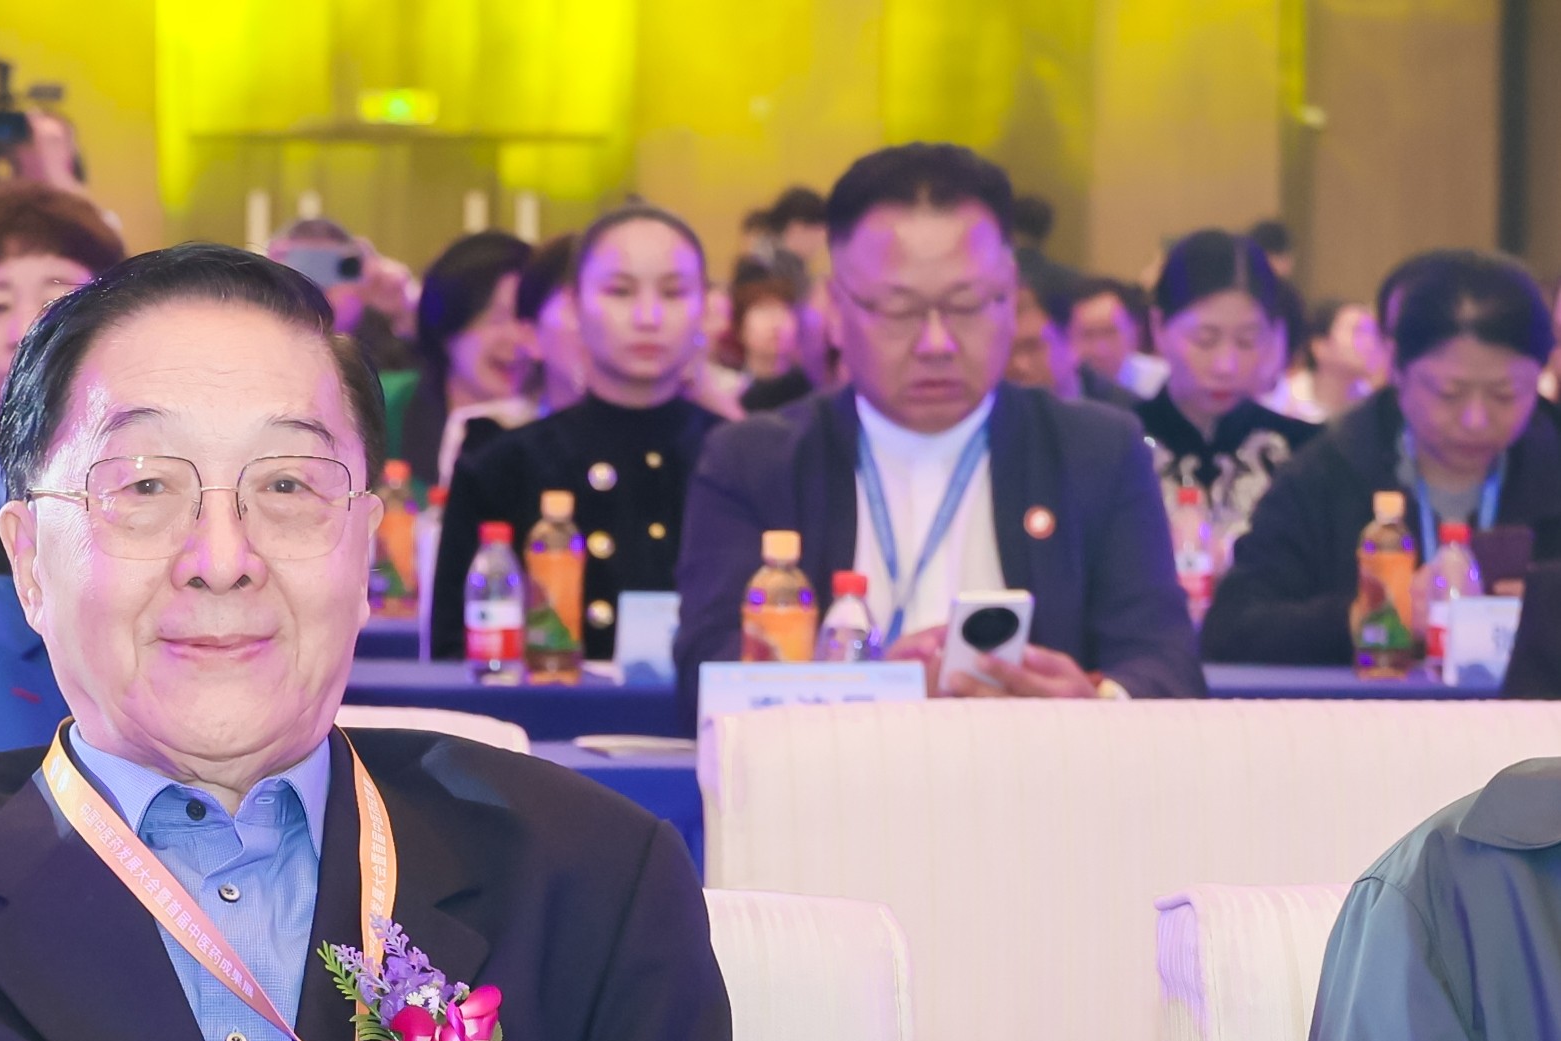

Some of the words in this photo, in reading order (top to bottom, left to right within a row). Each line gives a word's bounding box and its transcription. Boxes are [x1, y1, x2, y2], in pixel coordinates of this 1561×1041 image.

[79, 802, 254, 998] 中国中医药发展大会暨首届中医药成果展
